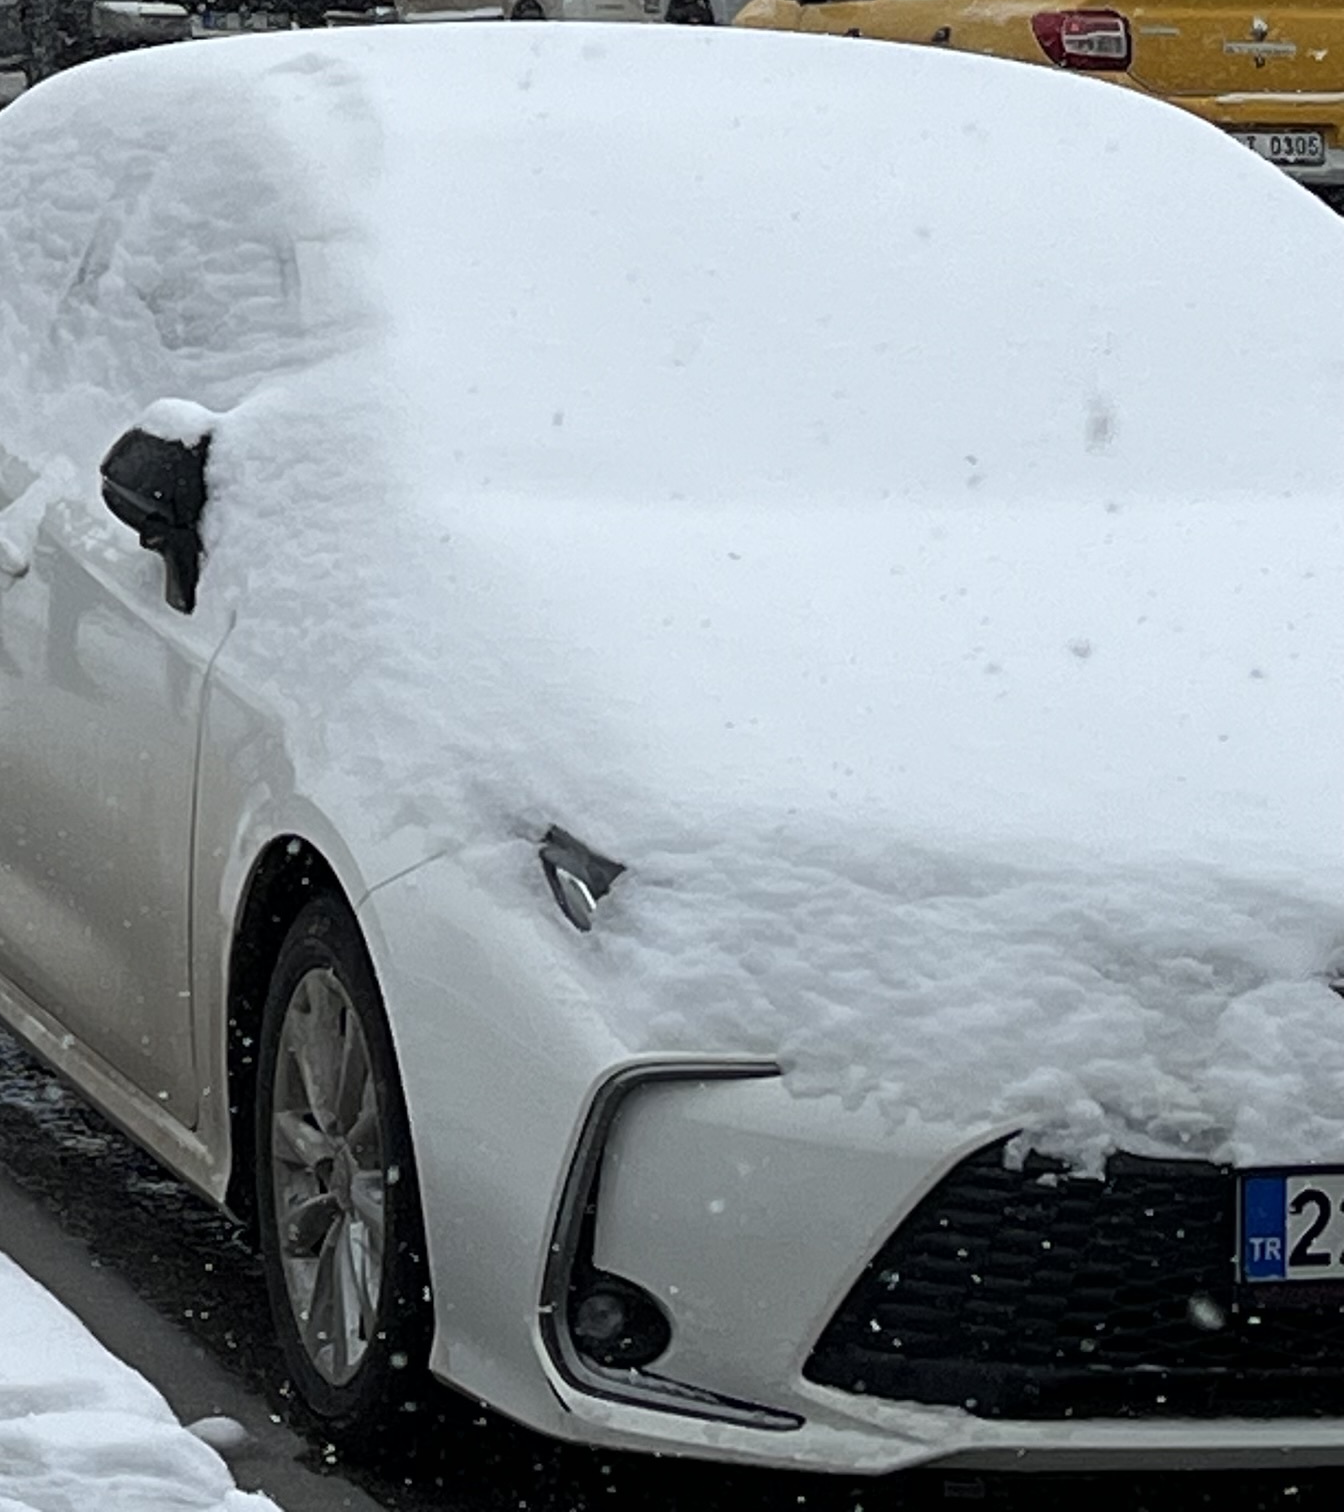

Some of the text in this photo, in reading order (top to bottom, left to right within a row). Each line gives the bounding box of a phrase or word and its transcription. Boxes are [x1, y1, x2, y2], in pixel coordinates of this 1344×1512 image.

[1271, 135, 1318, 156] 0305
[1288, 1189, 1344, 1267] 2
[1249, 1237, 1281, 1262] TR
